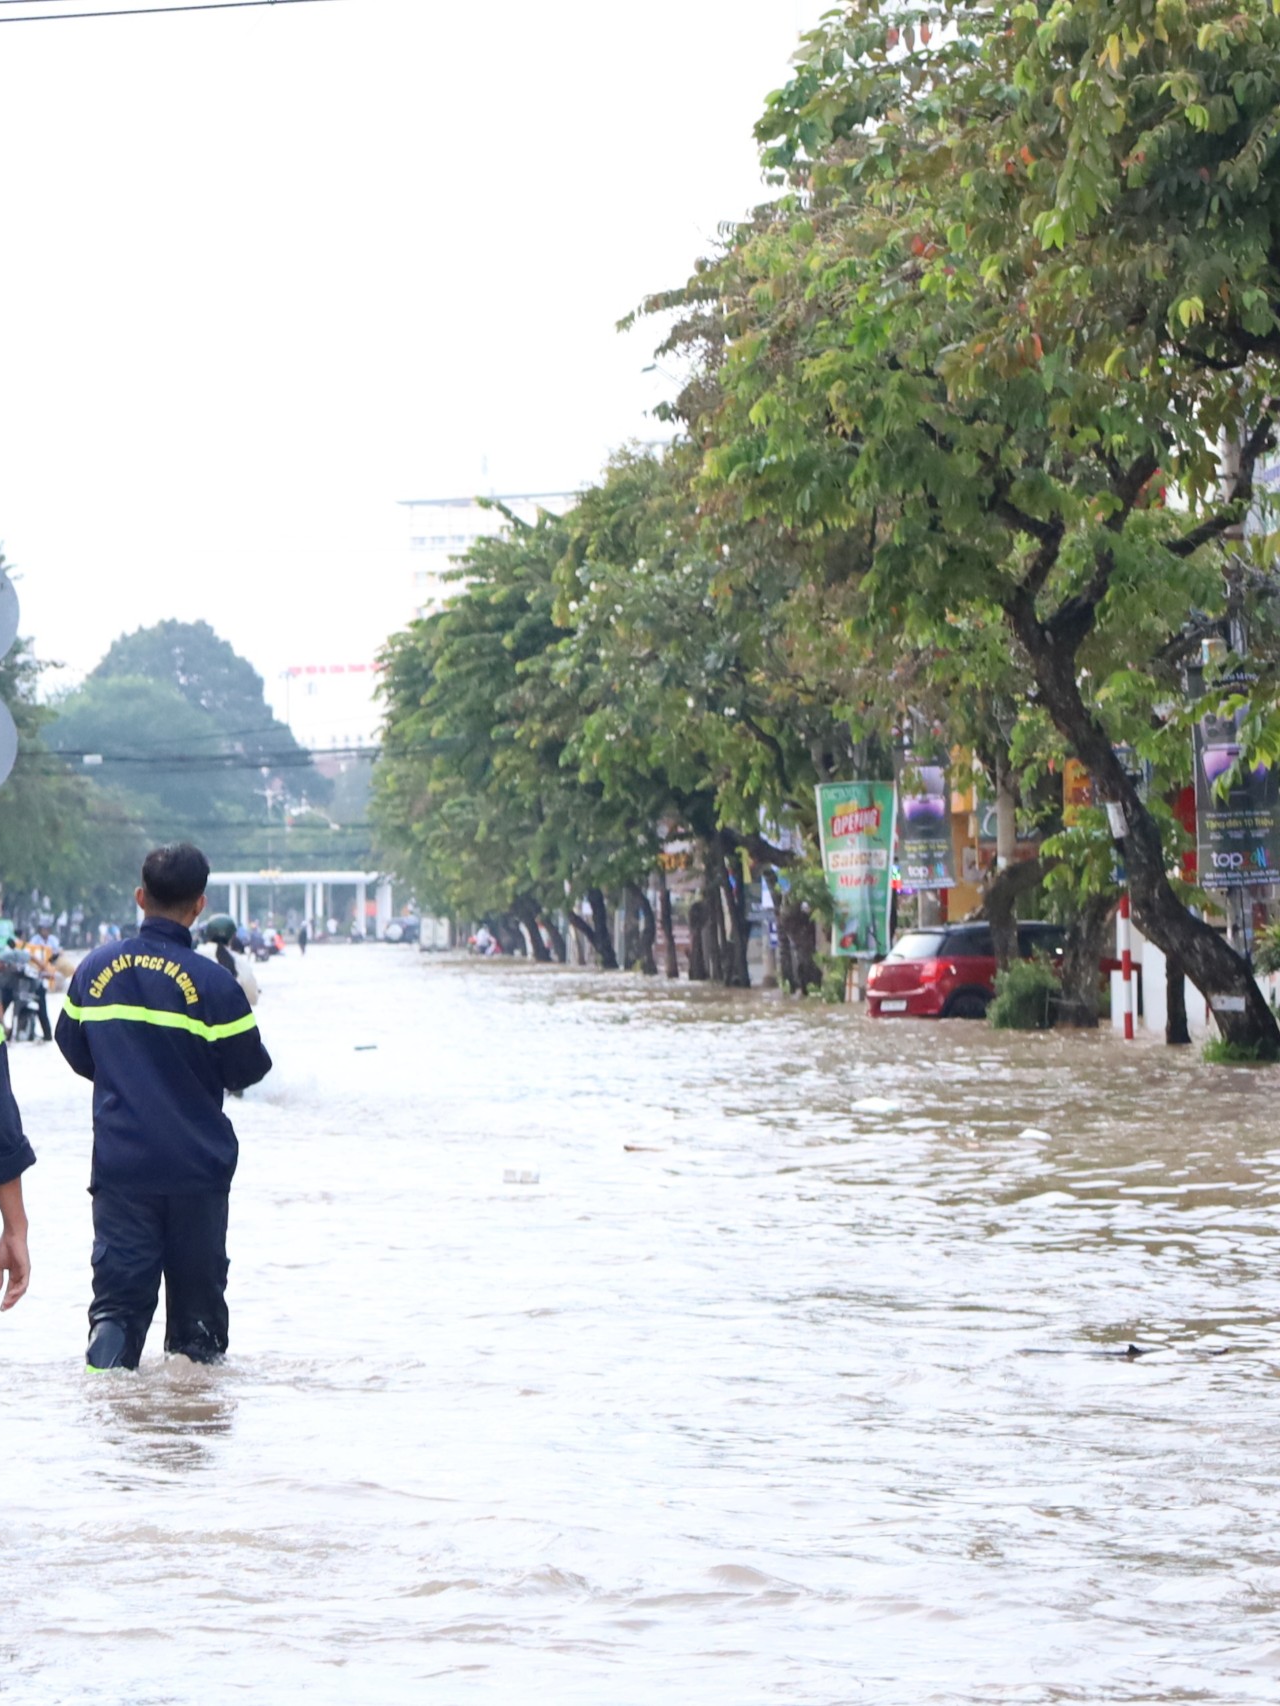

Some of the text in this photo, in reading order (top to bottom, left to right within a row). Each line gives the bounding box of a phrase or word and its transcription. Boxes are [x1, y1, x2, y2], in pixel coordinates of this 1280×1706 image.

[88, 953, 199, 1006] CẢNH SÁT PCCC VÀ CNCH
